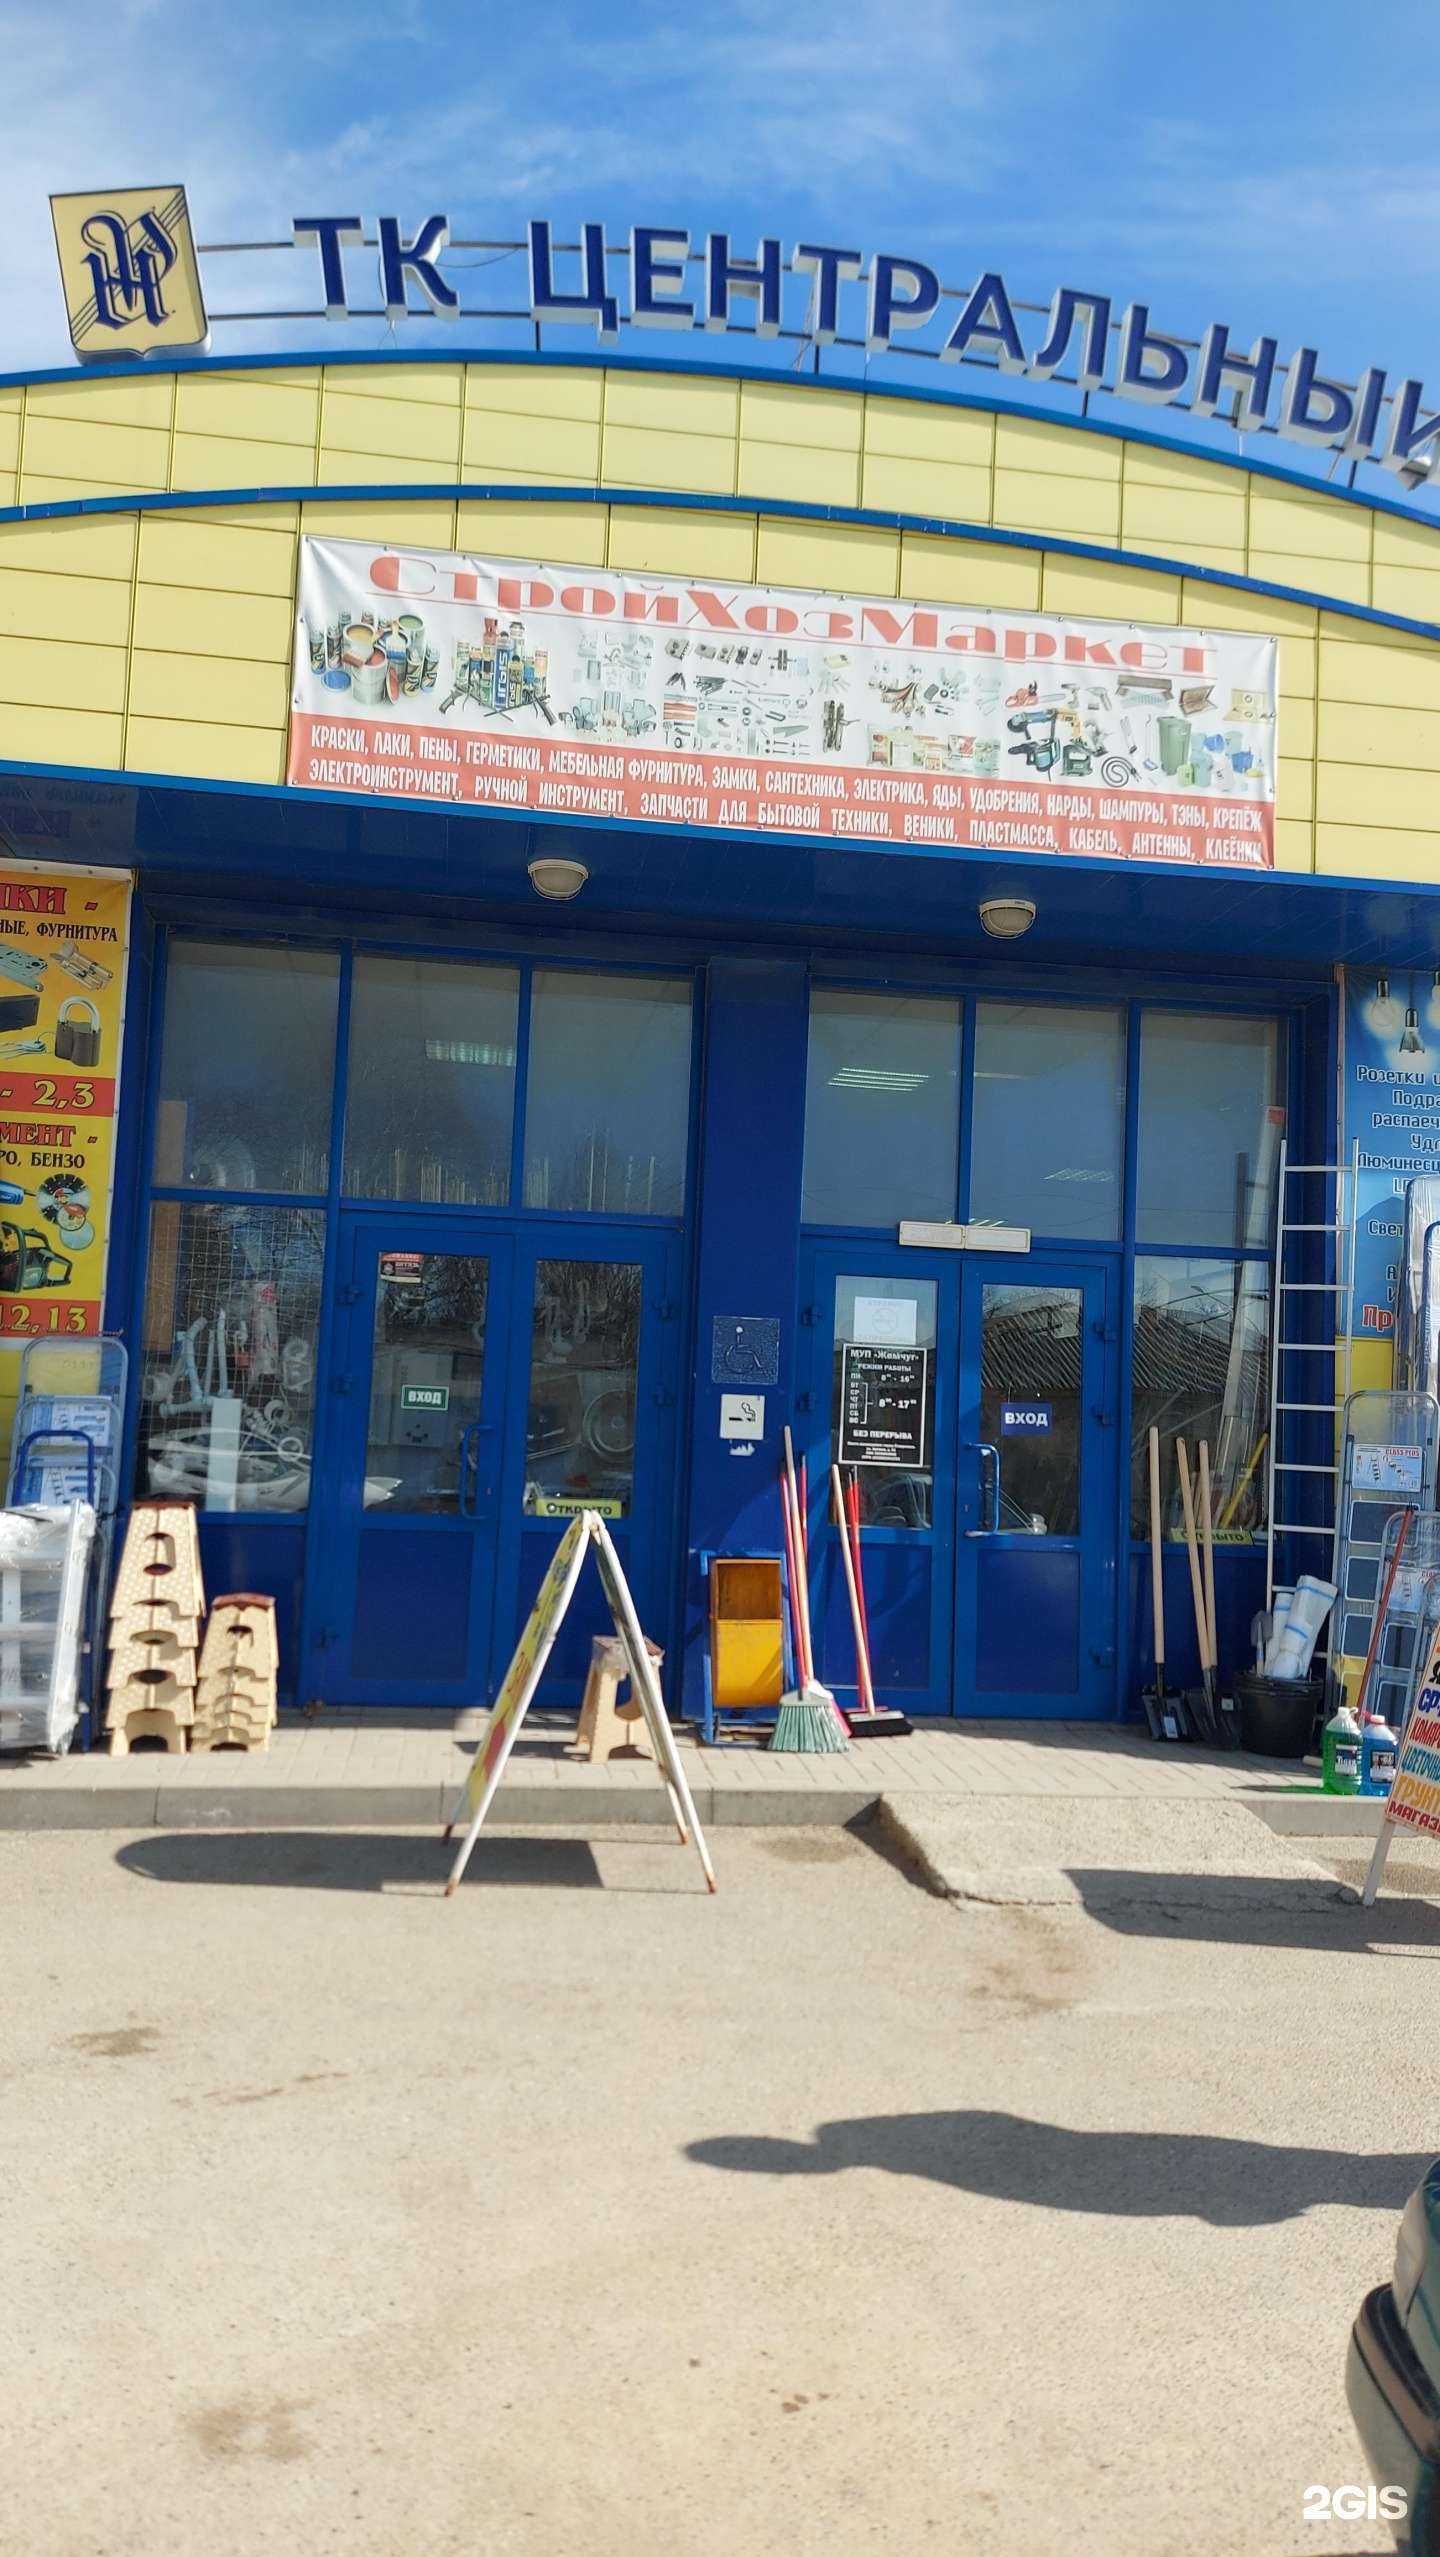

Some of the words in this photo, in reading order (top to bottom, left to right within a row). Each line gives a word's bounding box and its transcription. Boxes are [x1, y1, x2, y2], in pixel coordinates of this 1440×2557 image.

[292, 214, 460, 321] ТК
[370, 556, 1217, 673] СтройХозМаркет
[311, 725, 369, 754] КРАСКИ,
[374, 731, 414, 760] ЛАКИ,
[420, 736, 461, 765] ПЕНЫ,
[466, 740, 545, 773] ГЕРМЕТИКИ,
[549, 750, 624, 779] МЕБЕЛЬНАЯ
[628, 758, 708, 790] ФУРНИТУРА,
[712, 766, 761, 794] ЗАМКИ,
[765, 771, 849, 801] САНТЕХНИКА,
[853, 778, 928, 809] ЭЛЕКТРИКА,
[932, 786, 965, 811] ЯДЫ,
[969, 787, 1042, 817] УДОБРЕНИЯ,
[1047, 793, 1095, 821] НАРДЫ,
[1099, 798, 1167, 827] ШАМПУРЫ,
[1171, 803, 1209, 831] ТЭНЫ,
[1213, 803, 1262, 832] КРЕПЁЖ
[309, 758, 463, 798] ЭЛЕКТРОИНСТРУМЕНТ,
[475, 775, 528, 803] РУЧНОЙ
[539, 782, 629, 816] ИНСТРУМЕНТ,
[640, 792, 708, 820] ЗАПЧАСТИ
[718, 800, 747, 825] ДЛЯ
[757, 802, 820, 829] БЫТОВОЙ
[831, 808, 893, 836] ТЕХНИКИ,
[904, 815, 958, 842] ВЕНИКИ,
[969, 820, 1060, 849] ПЛАСТМАССА,
[1069, 828, 1122, 856] КАБЕЛЬ,
[1132, 832, 1196, 861] АНТЕННЫ,
[0, 883, 66, 914] КИ
[36, 922, 118, 942] ФУРНИТУРА
[1357, 1065, 1425, 1085] Розетки
[32, 1079, 95, 1109] 2,3
[31, 1152, 85, 1168] БЕНЗО
[850, 1349, 871, 1359] МУП
[408, 1391, 441, 1404] ВХОД
[1005, 1412, 1048, 1427] ВХОД
